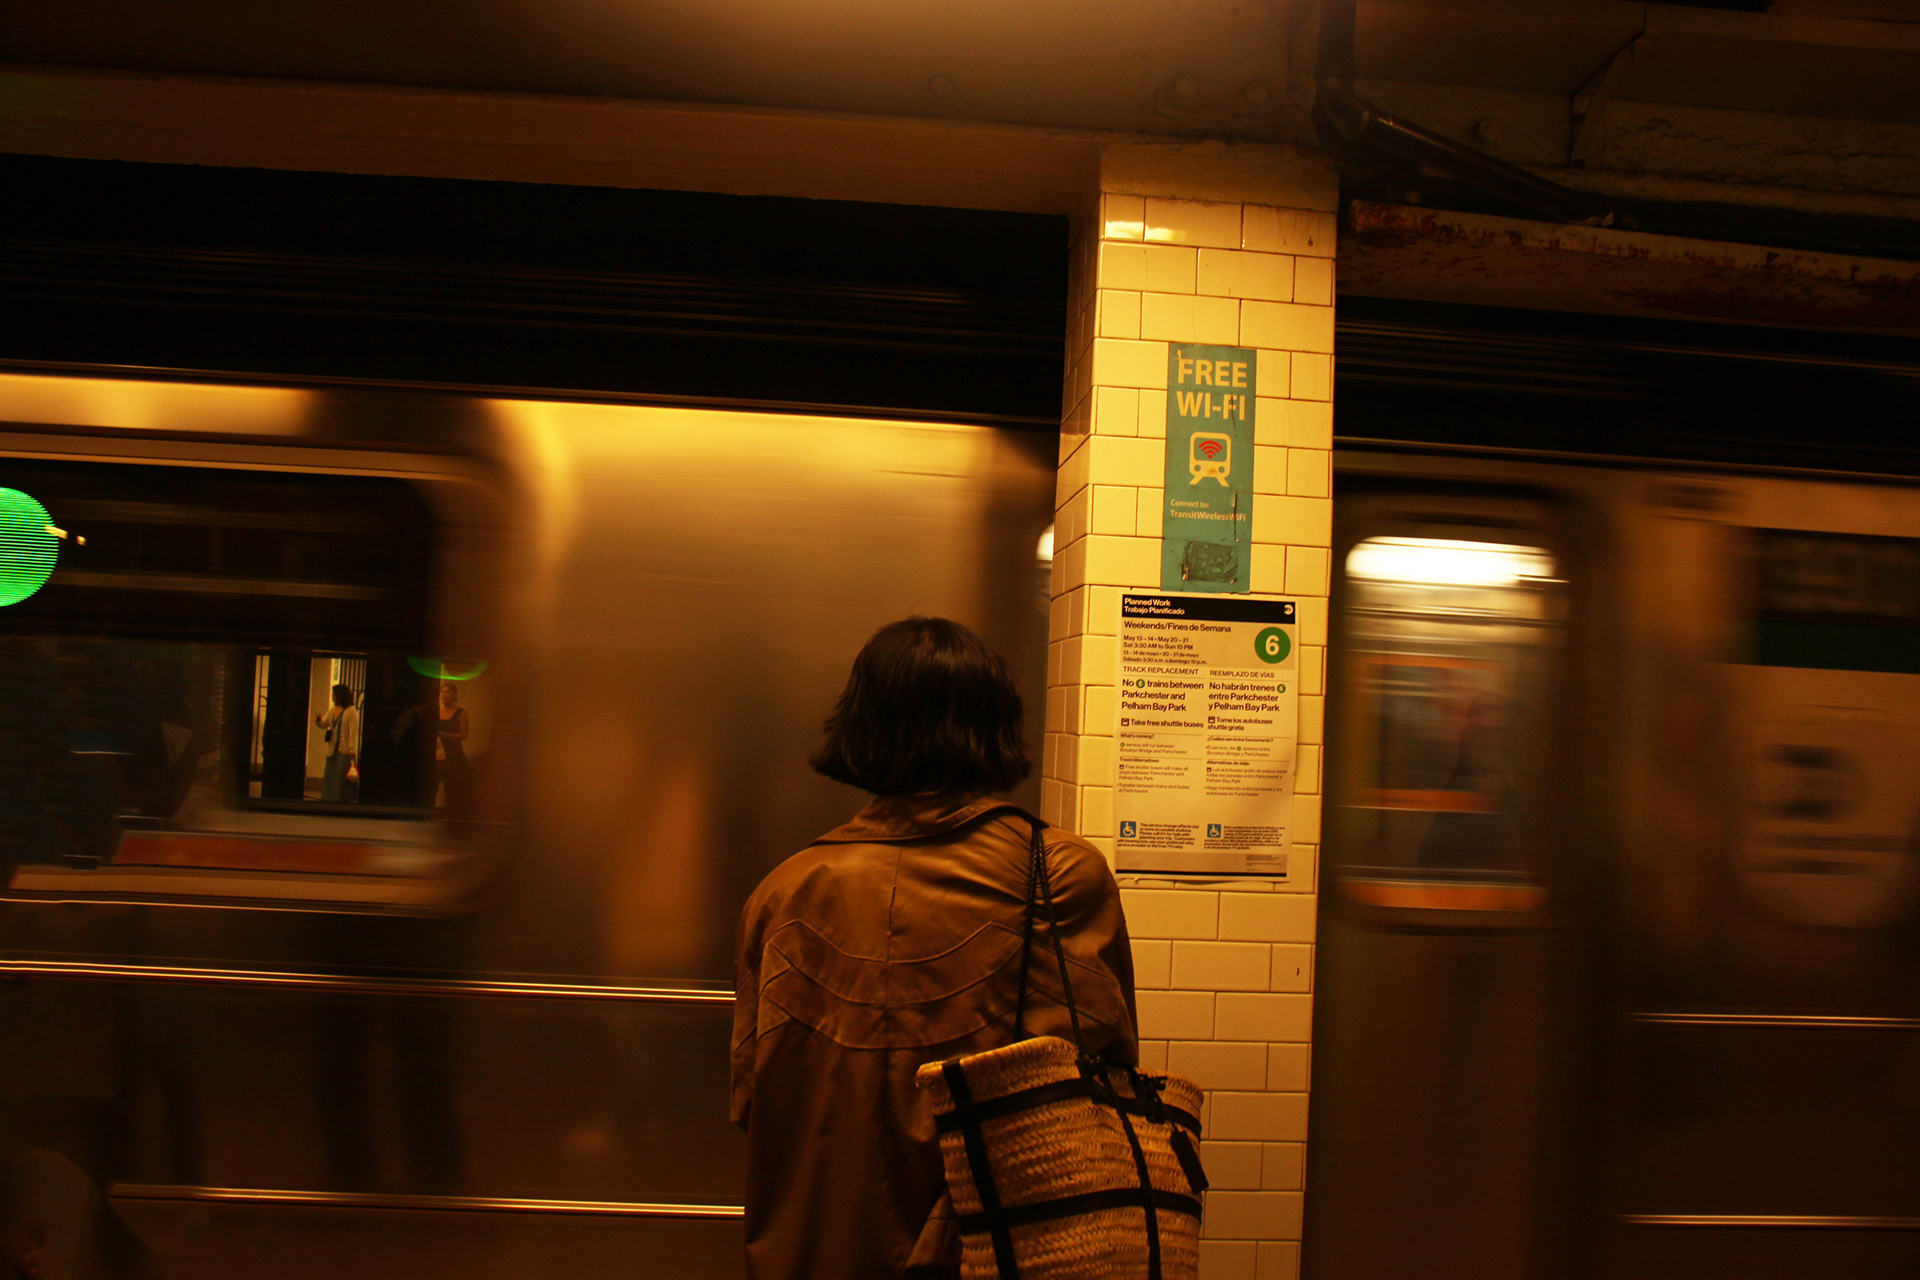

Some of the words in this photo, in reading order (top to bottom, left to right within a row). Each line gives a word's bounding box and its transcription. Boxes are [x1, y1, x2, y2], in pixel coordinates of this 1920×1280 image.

[1178, 359, 1247, 388] FREE
[1176, 391, 1246, 420] WI-FI
[1124, 606, 1148, 614] Trabajo
[1124, 621, 1188, 630] Weekends/Fines
[1200, 624, 1231, 632] Semana
[1266, 635, 1279, 656] 6
[1148, 667, 1198, 675] REPLACEMENT
[1170, 681, 1204, 689] between
[1122, 690, 1169, 699] Parkchester
[1230, 693, 1278, 701] Parkchester
[1122, 702, 1151, 710] Pelham
[1153, 703, 1167, 712] Bay
[1214, 702, 1244, 710] Pelham
[1245, 703, 1260, 712] Bay
